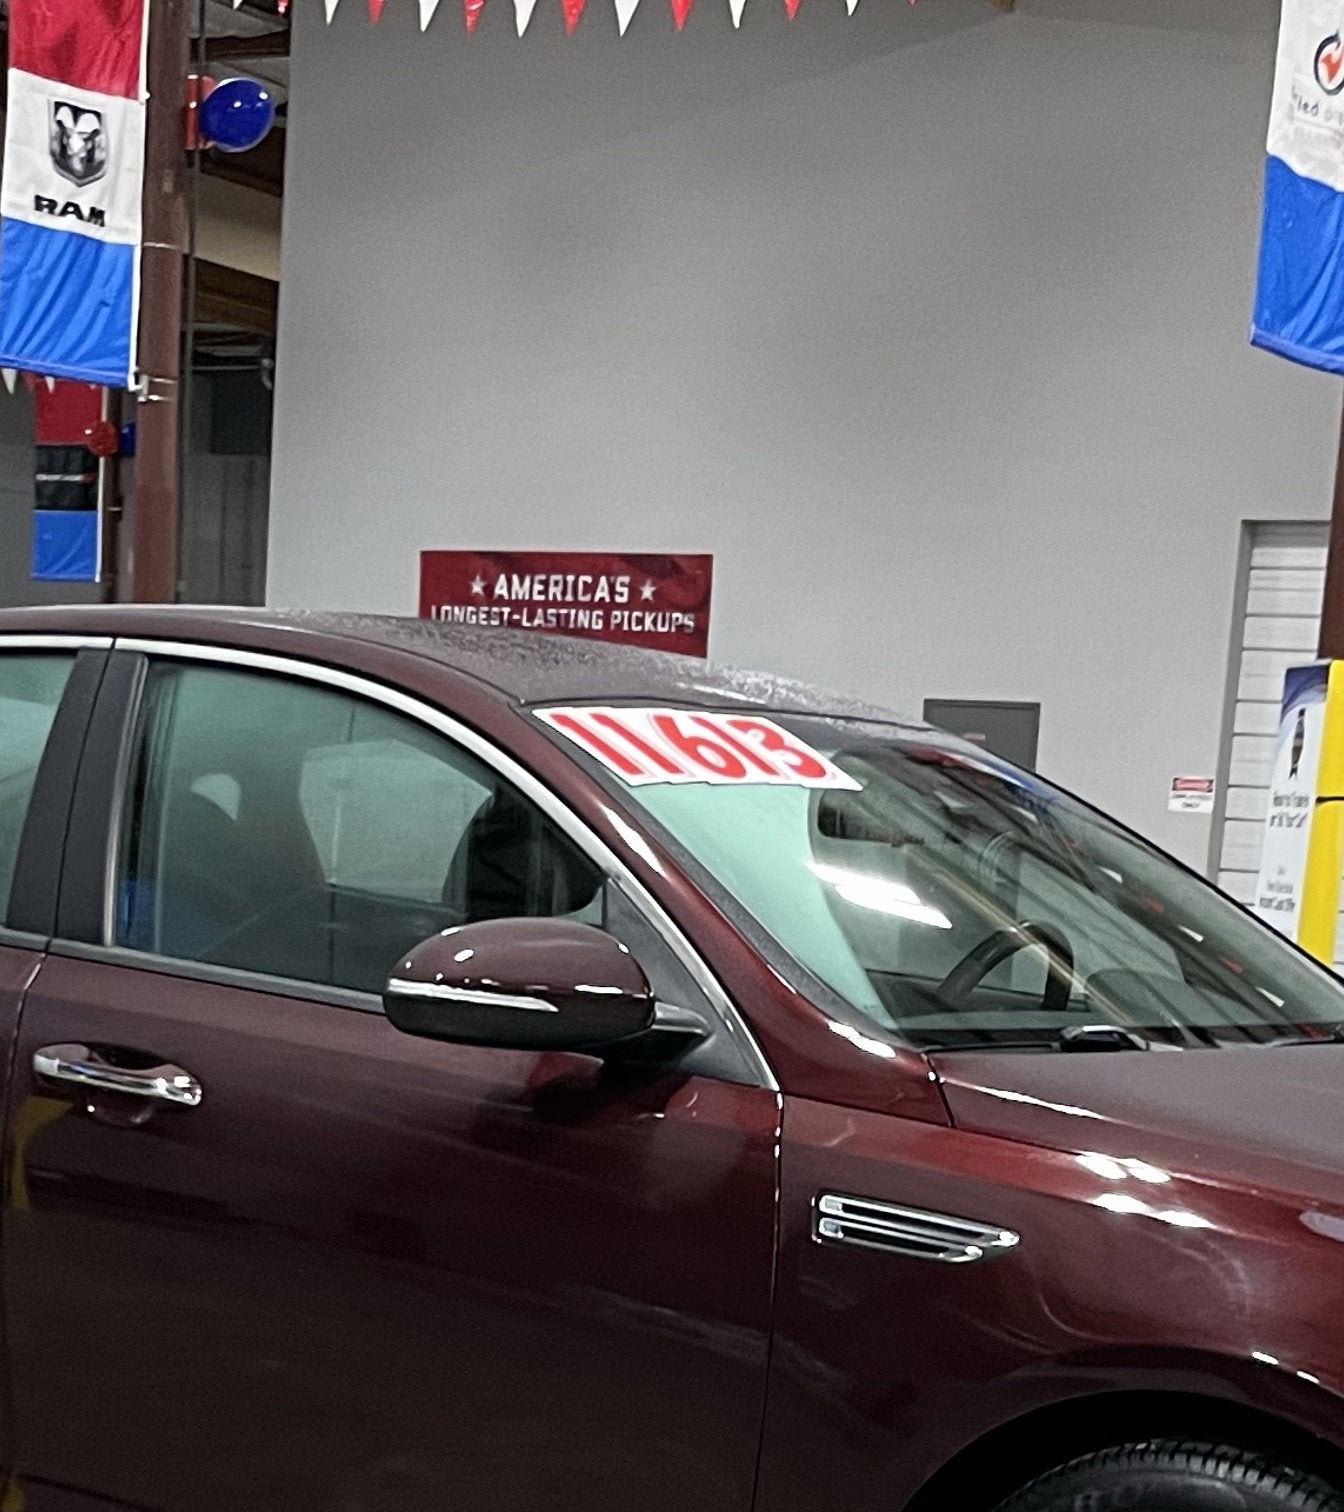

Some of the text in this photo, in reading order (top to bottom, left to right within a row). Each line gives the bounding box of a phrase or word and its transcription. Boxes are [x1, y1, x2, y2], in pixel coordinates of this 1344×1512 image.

[34, 194, 105, 227] RAM
[493, 573, 630, 604] AMERICA'S
[431, 604, 696, 634] LONGEST-LASTING PICKUPS
[549, 713, 829, 779] 11613
